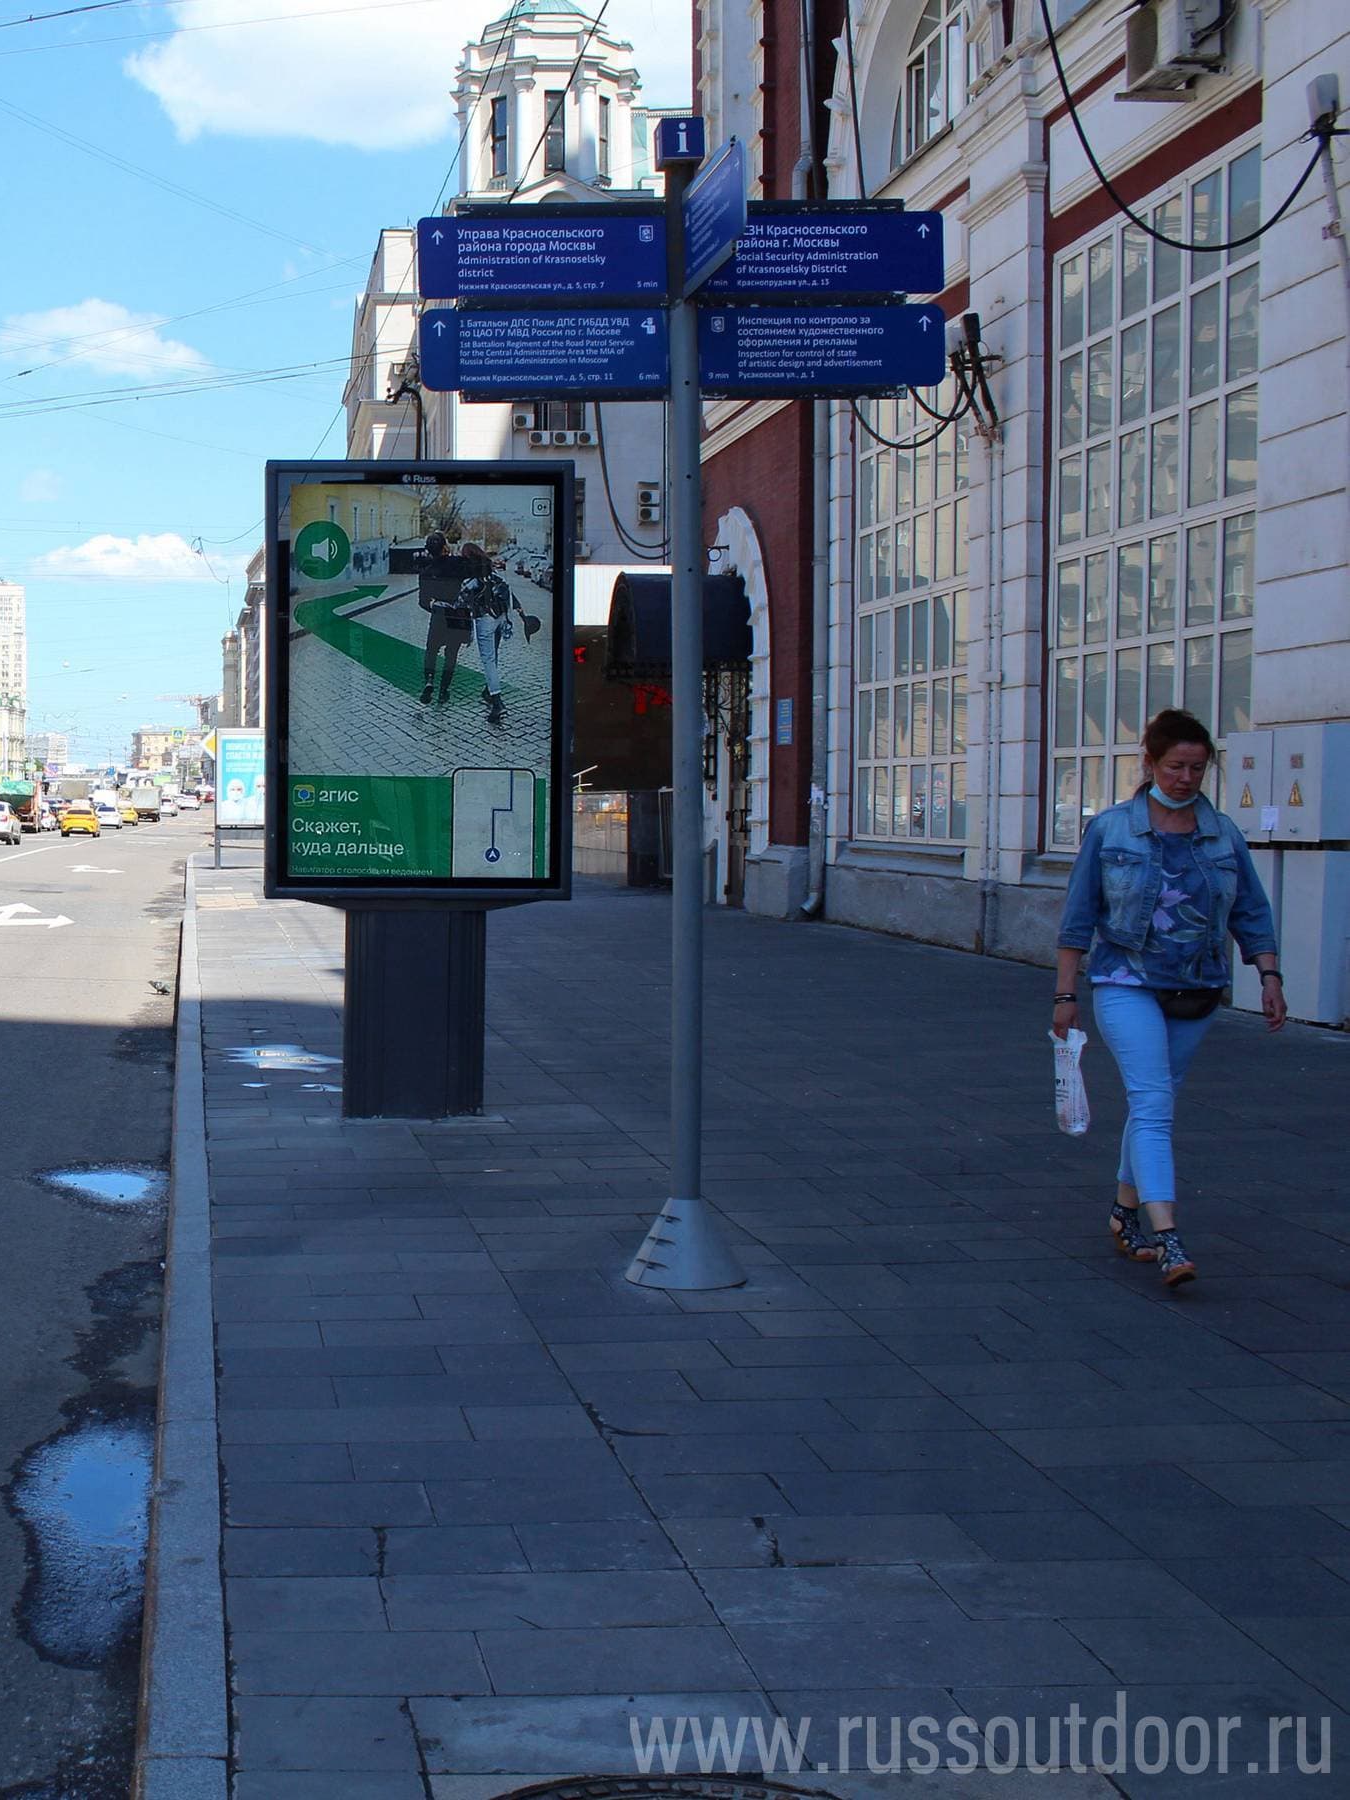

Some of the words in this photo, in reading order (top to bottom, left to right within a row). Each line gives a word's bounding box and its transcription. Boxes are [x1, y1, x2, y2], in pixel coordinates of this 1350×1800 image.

[458, 229, 499, 241] Управа
[503, 228, 604, 240] Красносельского
[767, 225, 867, 237] Красносельского
[458, 242, 502, 254] района
[505, 242, 546, 253] города
[549, 241, 596, 250] Москвы
[736, 238, 779, 251] района
[783, 240, 790, 248] г.
[793, 238, 839, 248] Москвы
[458, 256, 530, 264] Administration
[532, 255, 542, 264] of
[545, 255, 606, 265] Krasnoselsky
[736, 252, 763, 261] Social
[766, 252, 804, 262] Security
[807, 251, 878, 260] Administration
[458, 269, 494, 277] district
[737, 265, 747, 273] of
[749, 264, 809, 274] Krasnoselsky
[811, 264, 847, 273] District
[491, 283, 551, 291] Красносельская
[584, 282, 598, 290] стр.
[467, 320, 508, 328] Батальон
[511, 319, 530, 328] ДПС
[532, 319, 554, 327] Полк
[557, 318, 576, 327] ДПС
[578, 318, 609, 327] ГИБДД
[611, 318, 630, 327] УВД
[738, 316, 791, 326] Инспекция
[809, 317, 857, 326] контролю
[473, 330, 492, 338] ЦАО
[495, 329, 505, 337] ГУ
[508, 329, 529, 338] МВД
[587, 328, 621, 336] Москве
[738, 328, 795, 336] состоянием
[798, 327, 884, 336] художественного
[507, 340, 540, 349] Regiment
[565, 339, 583, 347] Road
[738, 338, 801, 348] оформления
[804, 338, 810, 346] и
[812, 338, 857, 348] рекламы
[514, 348, 566, 356] Administrative
[617, 347, 624, 355] of
[738, 350, 780, 359] Inspection
[578, 356, 608, 364] Moscow
[749, 359, 776, 367] artistic
[778, 359, 804, 368] design
[824, 359, 882, 367] advertisement
[492, 374, 553, 382] Красносельская
[739, 371, 784, 380] Русаковская
[413, 474, 436, 483] Russ
[318, 789, 359, 802] 2ГИС
[292, 818, 362, 836] Скажет,
[292, 842, 332, 856] куда
[335, 842, 404, 856] дальше
